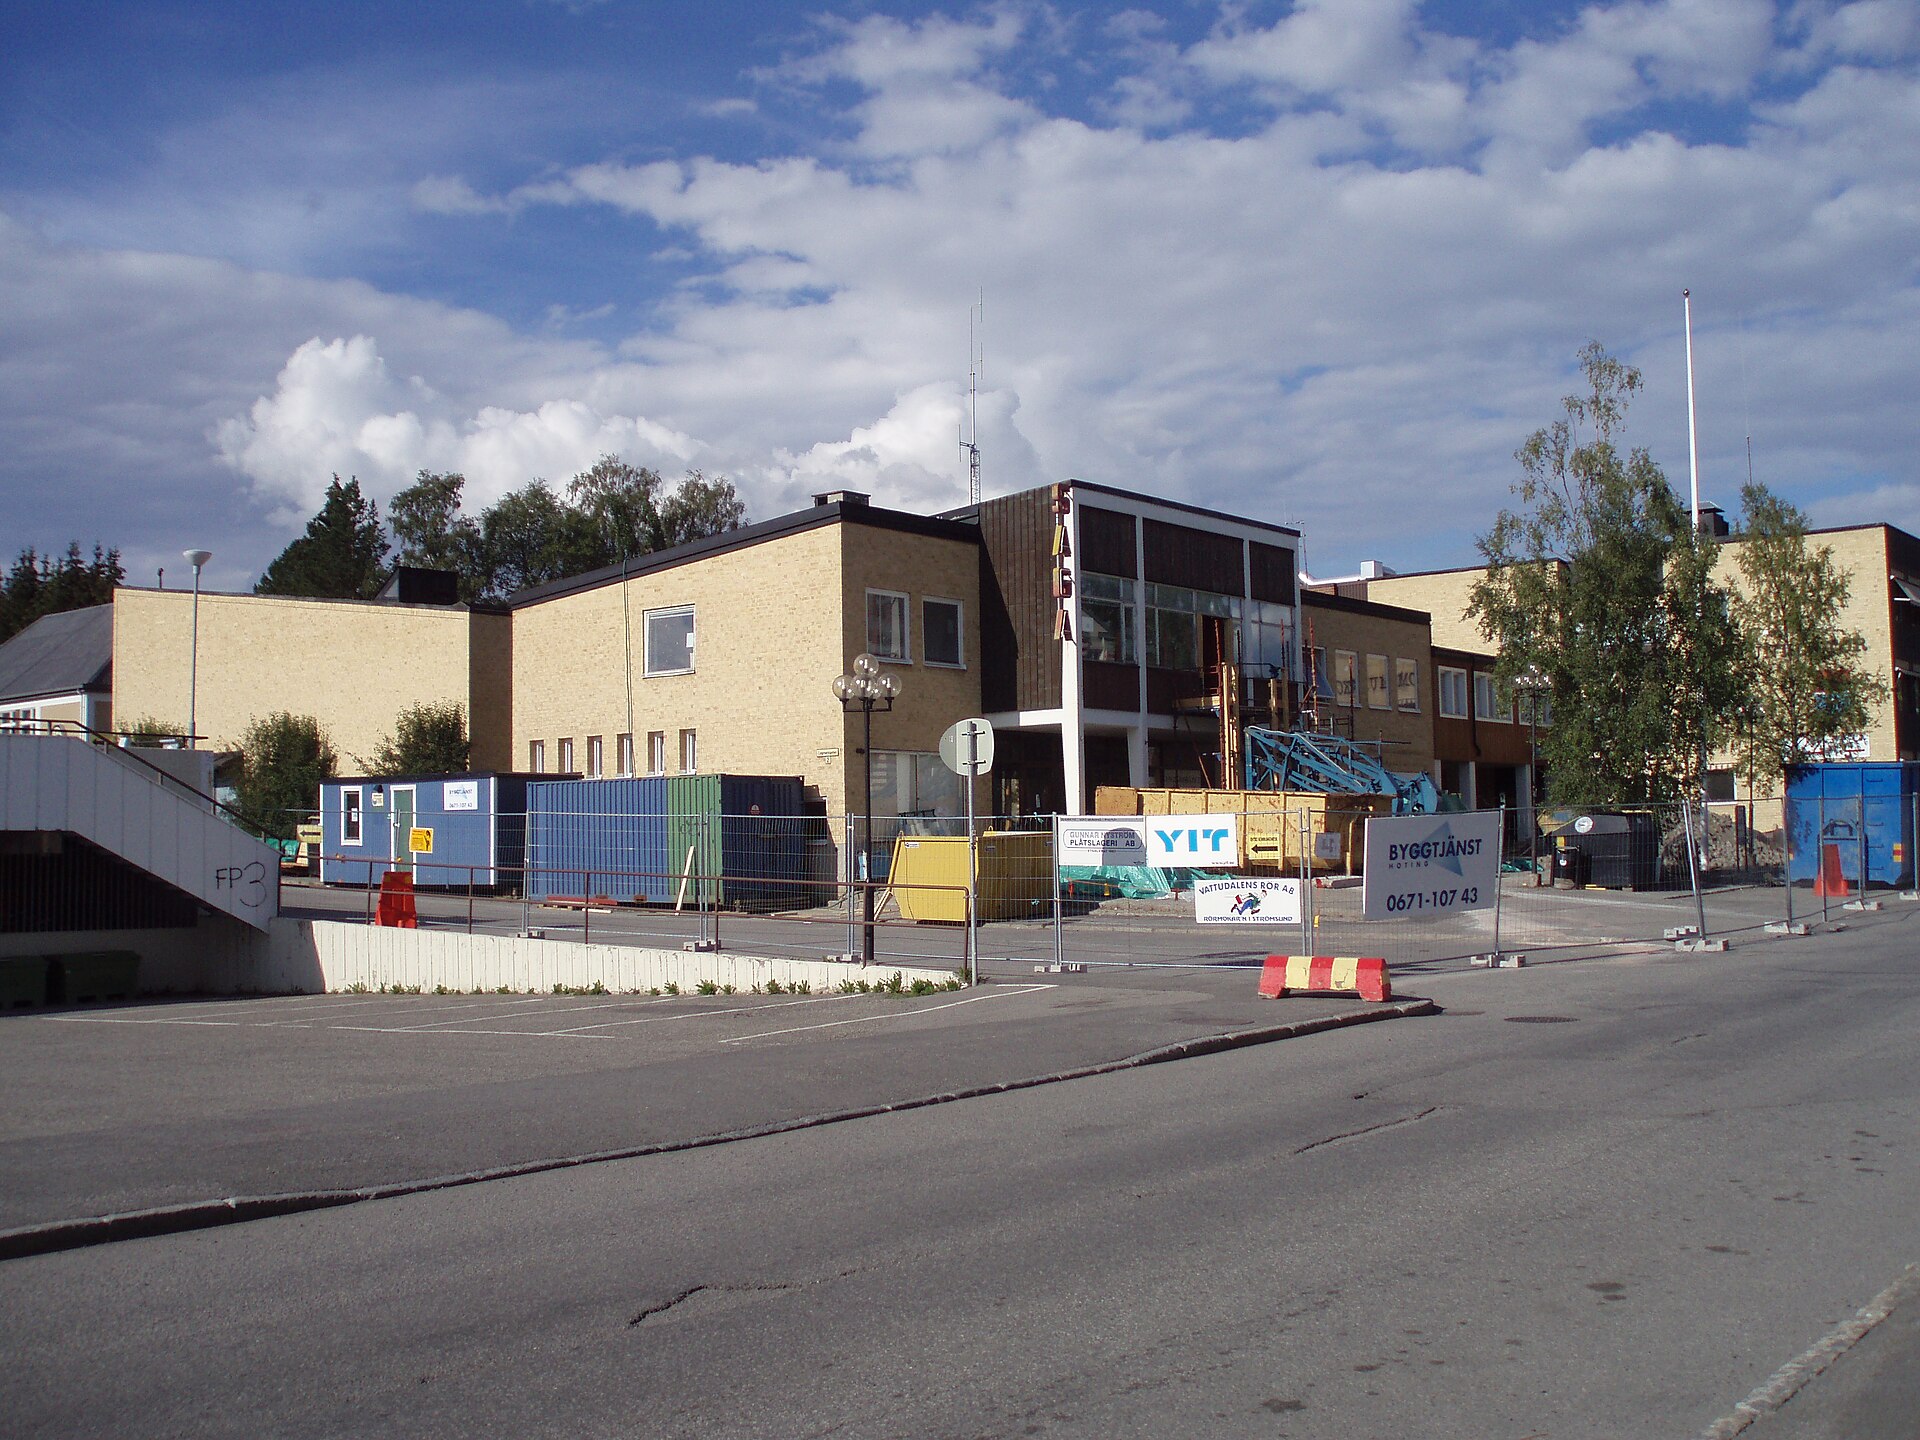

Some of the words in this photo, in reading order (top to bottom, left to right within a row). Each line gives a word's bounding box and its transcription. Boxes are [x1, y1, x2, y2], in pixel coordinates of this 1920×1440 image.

[1052, 483, 1072, 641] SAGA
[1069, 831, 1099, 839] GUNNAR
[1101, 831, 1136, 839] NYSTRÖM
[1069, 838, 1118, 847] PLÅTSLAGERI
[1154, 829, 1229, 853] YIT
[1389, 835, 1482, 861] BYGGTJÄNST
[1388, 860, 1429, 869] HOTING
[1199, 881, 1258, 895] VATTUDALENS
[1260, 881, 1279, 891] RÖR
[1282, 885, 1295, 895] AB
[1386, 889, 1458, 912] 0671-107
[1461, 887, 1478, 904] 43
